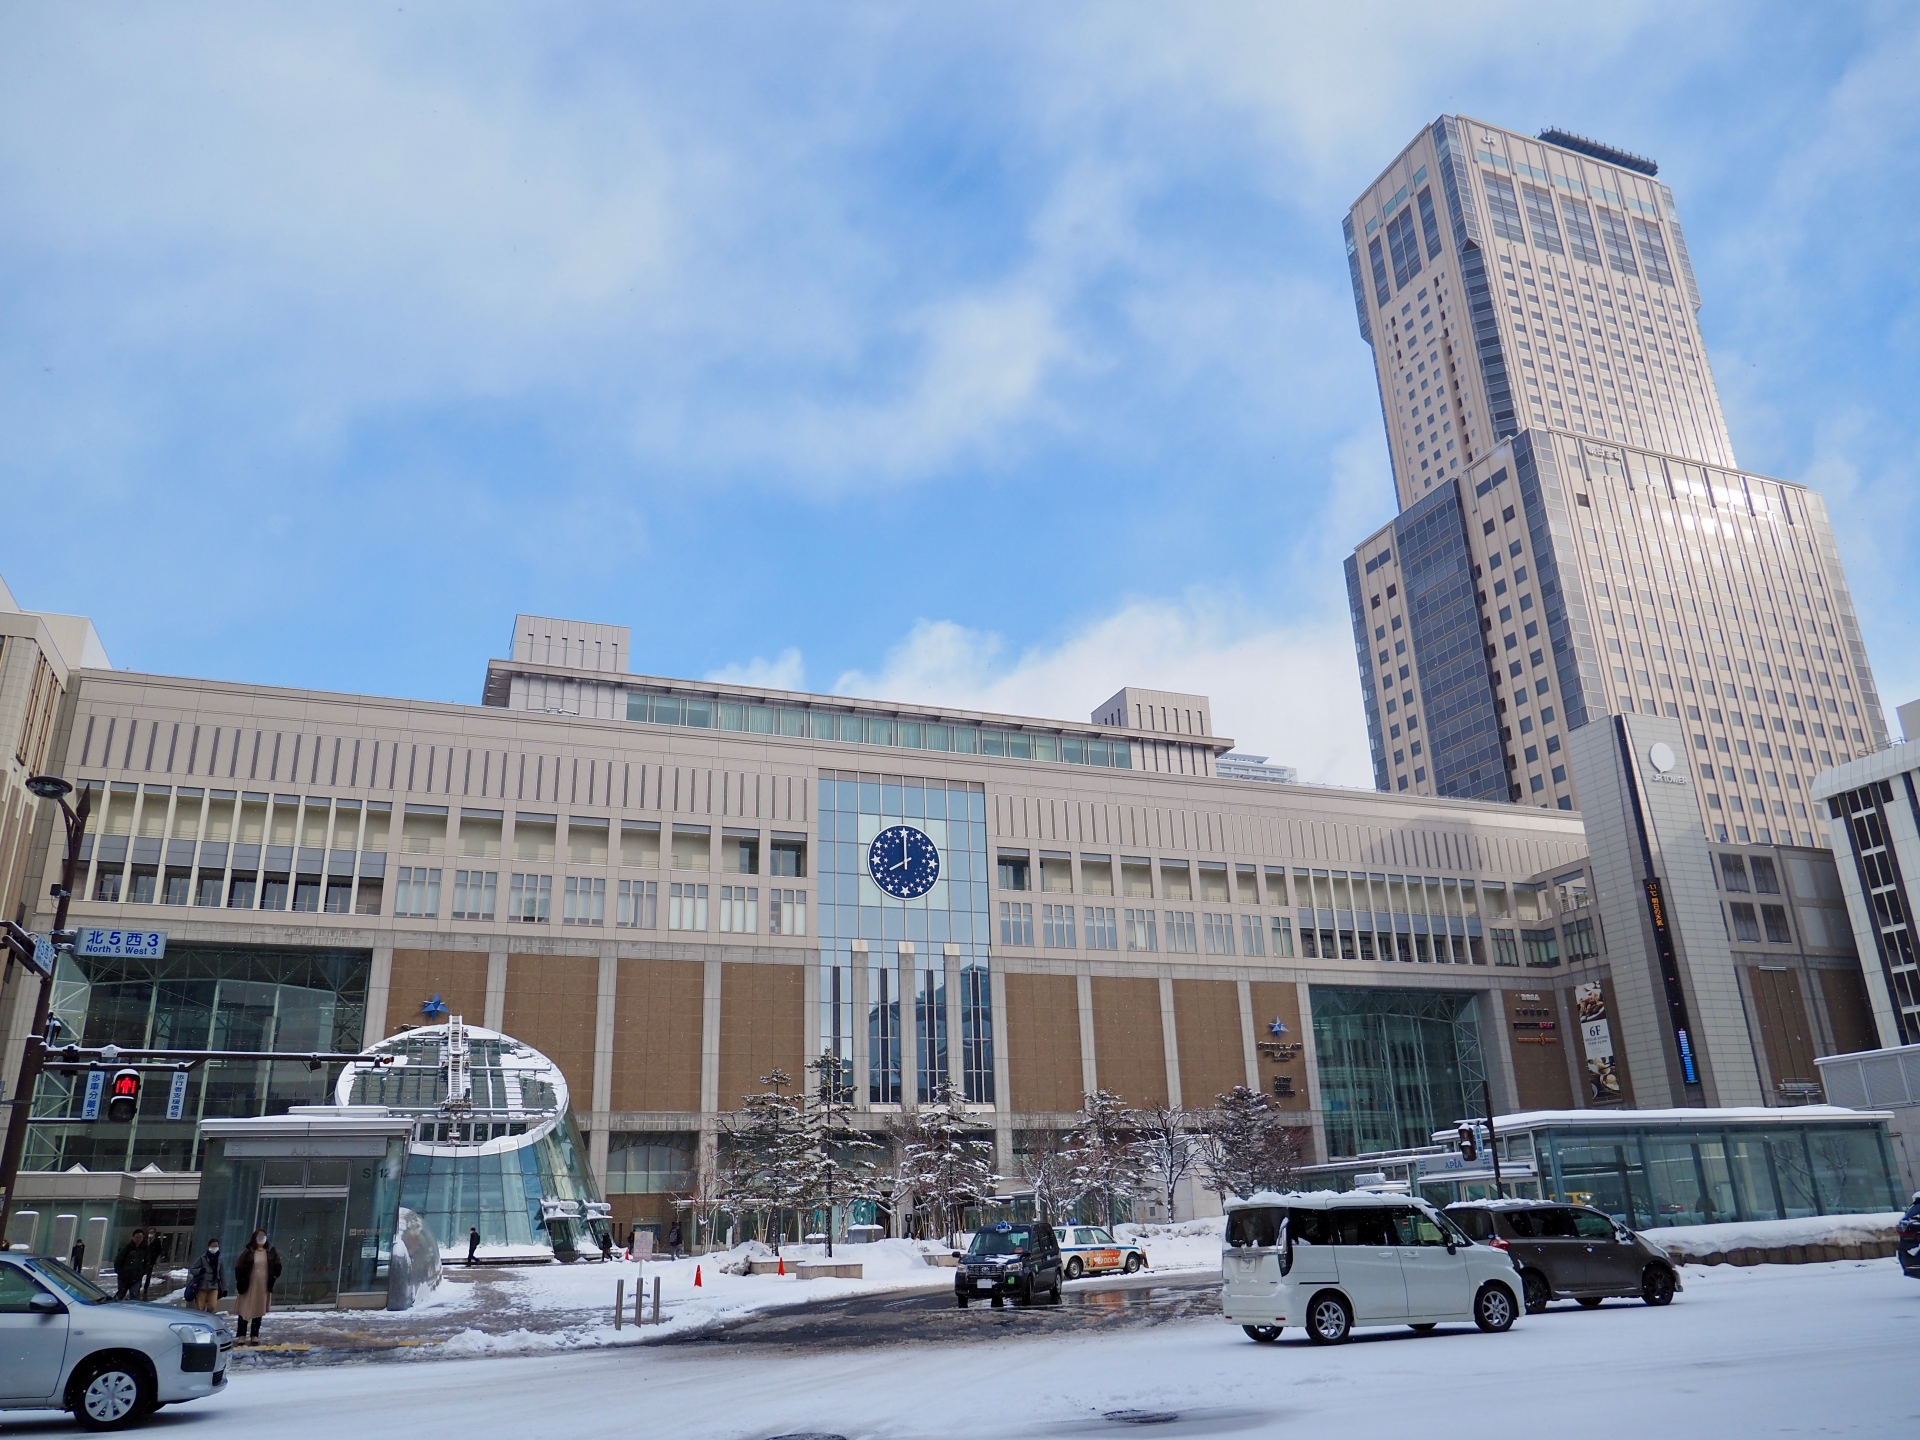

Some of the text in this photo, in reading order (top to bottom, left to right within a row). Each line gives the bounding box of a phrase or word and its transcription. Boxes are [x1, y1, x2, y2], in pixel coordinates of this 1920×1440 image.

[87, 930, 159, 948] 北5西3
[85, 944, 157, 956] North 5 West 3
[1589, 1024, 1601, 1037] 6F
[1258, 1041, 1302, 1050] STELLAR
